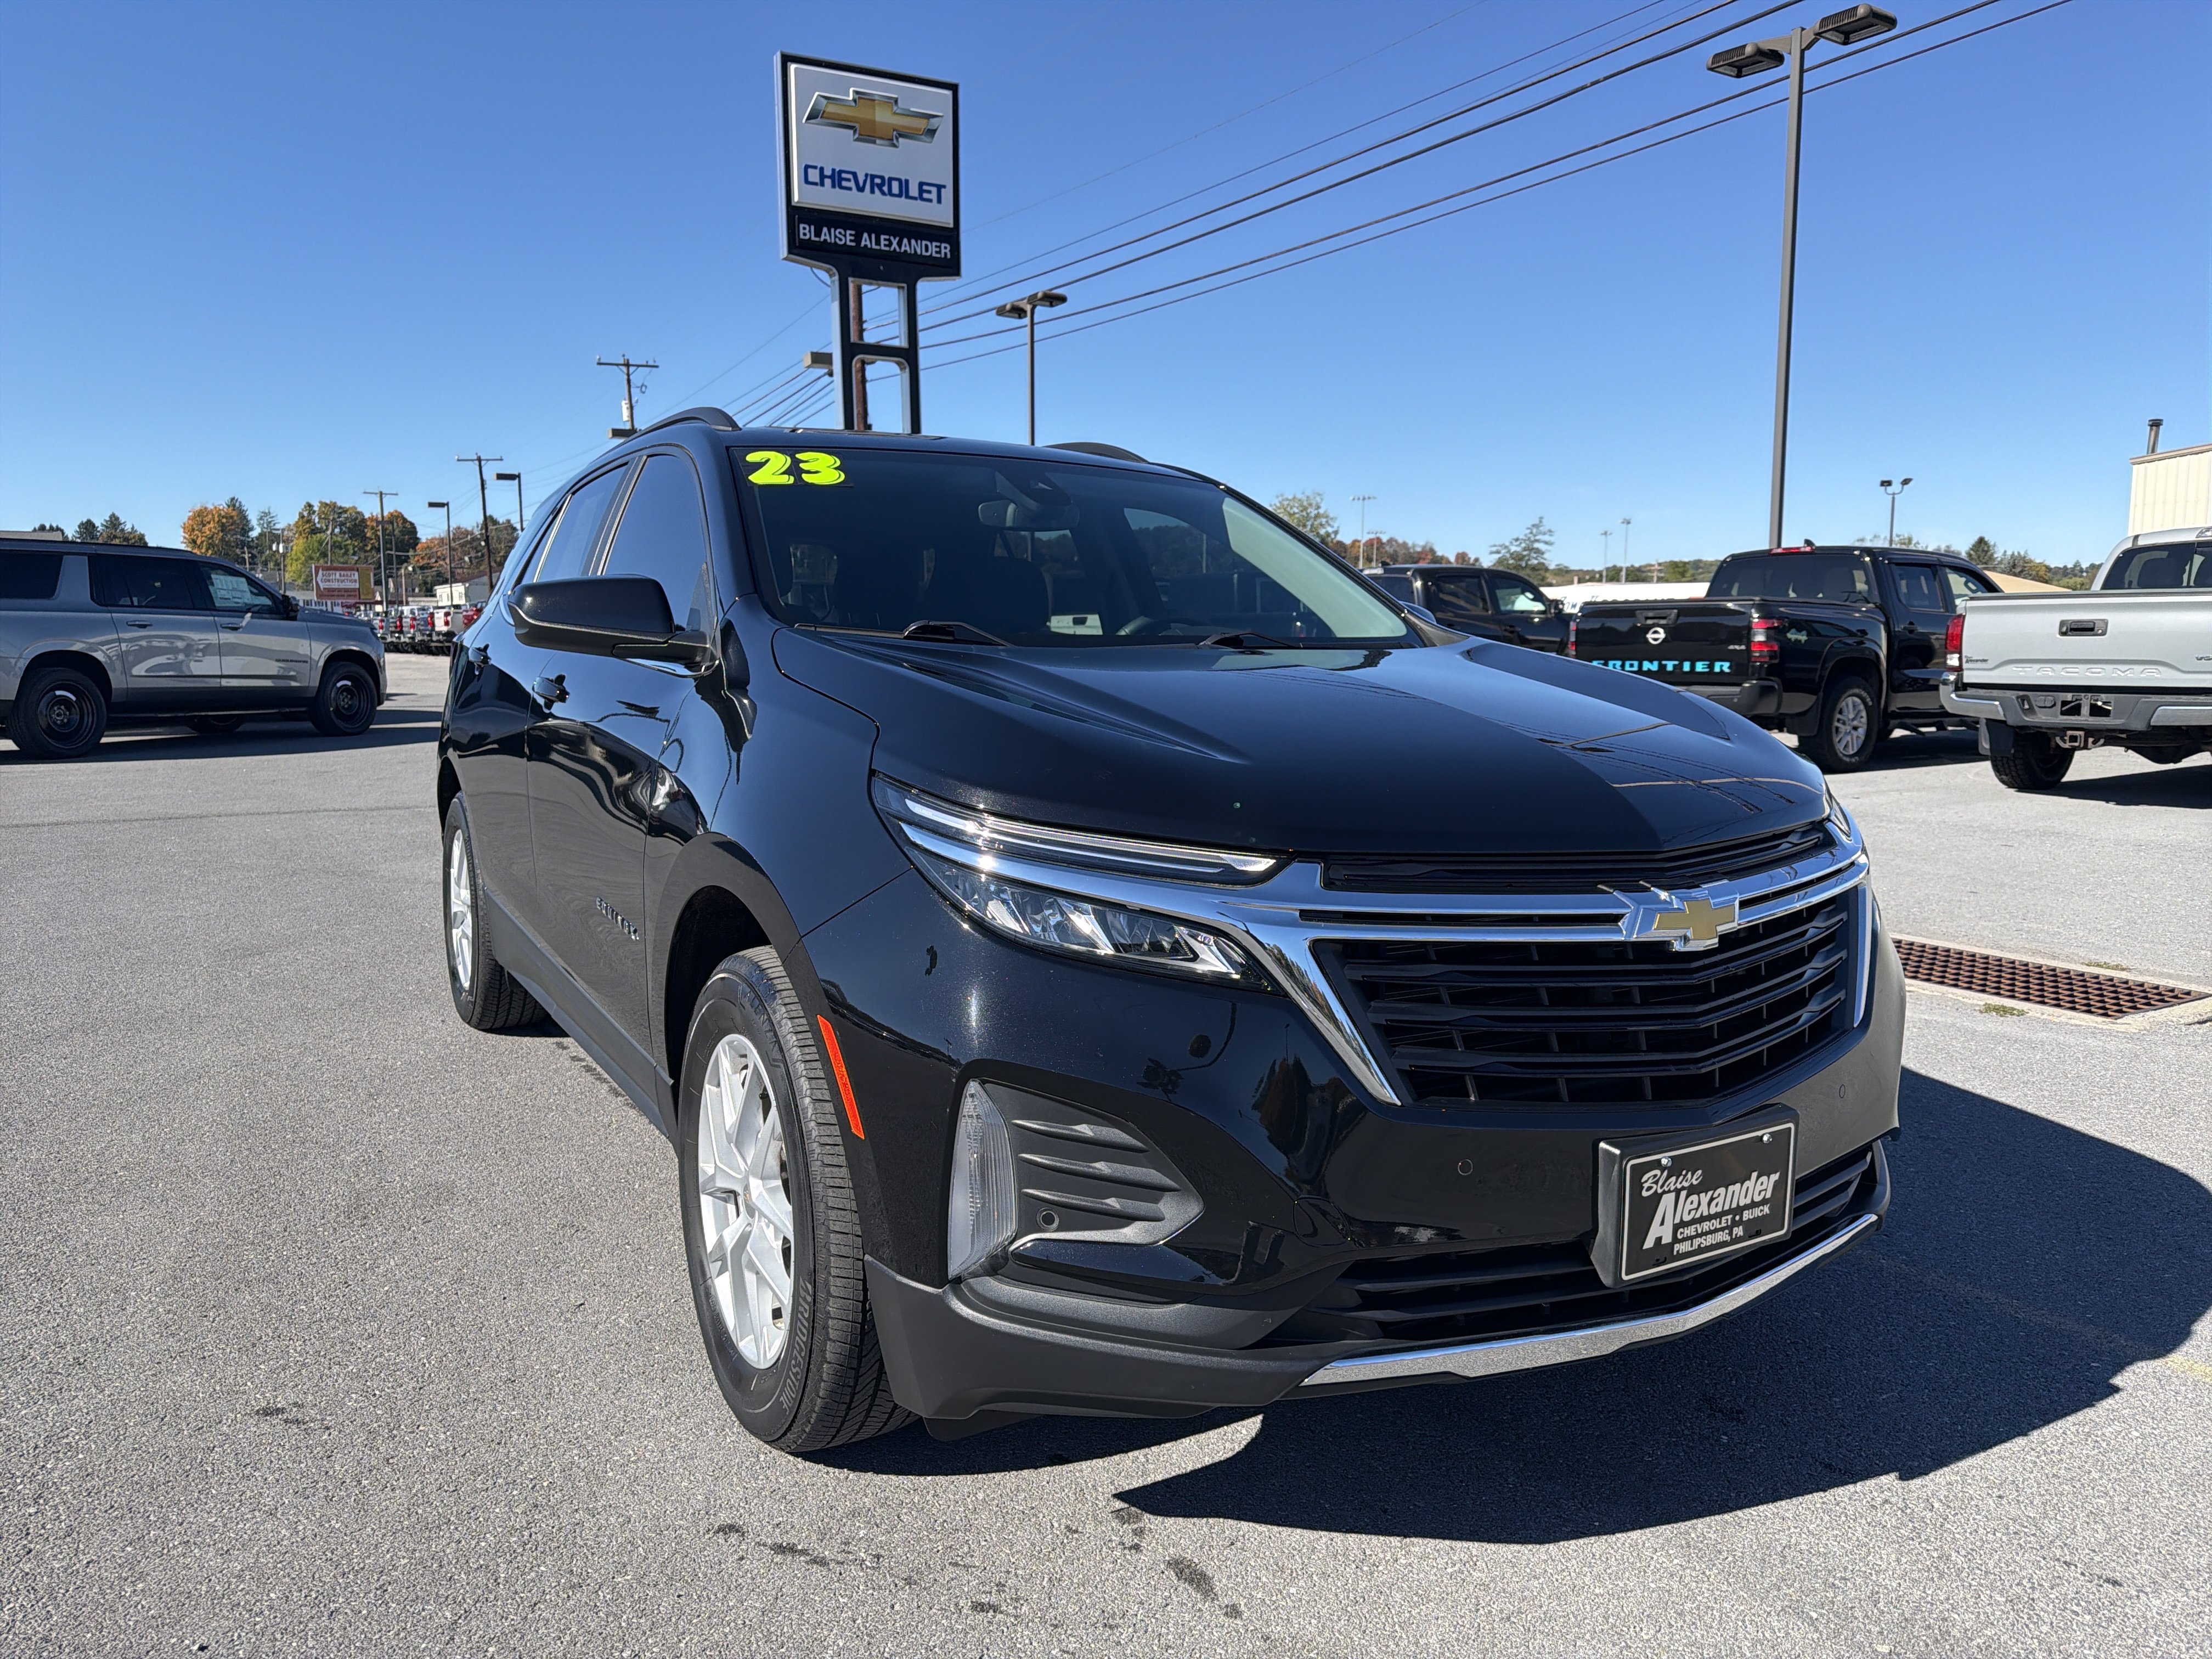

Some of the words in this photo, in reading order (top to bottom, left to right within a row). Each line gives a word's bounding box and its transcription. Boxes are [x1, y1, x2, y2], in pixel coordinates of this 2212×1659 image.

[804, 164, 946, 204] CHEVROLET
[799, 223, 856, 246] BLAISE
[861, 232, 951, 259] ALEXANDER
[746, 451, 845, 485] 23
[1592, 660, 1731, 673] FRONTIER
[2012, 666, 2162, 677] TACOMA
[1641, 1169, 1703, 1197] Blaise
[1643, 1171, 1780, 1250] Alexander
[1677, 1215, 1733, 1239] CHEVROLET
[1742, 1204, 1770, 1221] BUICK
[1673, 1229, 1731, 1255] PHILIPSBURG,
[1733, 1225, 1743, 1239] PA
[780, 1275, 812, 1415] BRIDGESTONE
